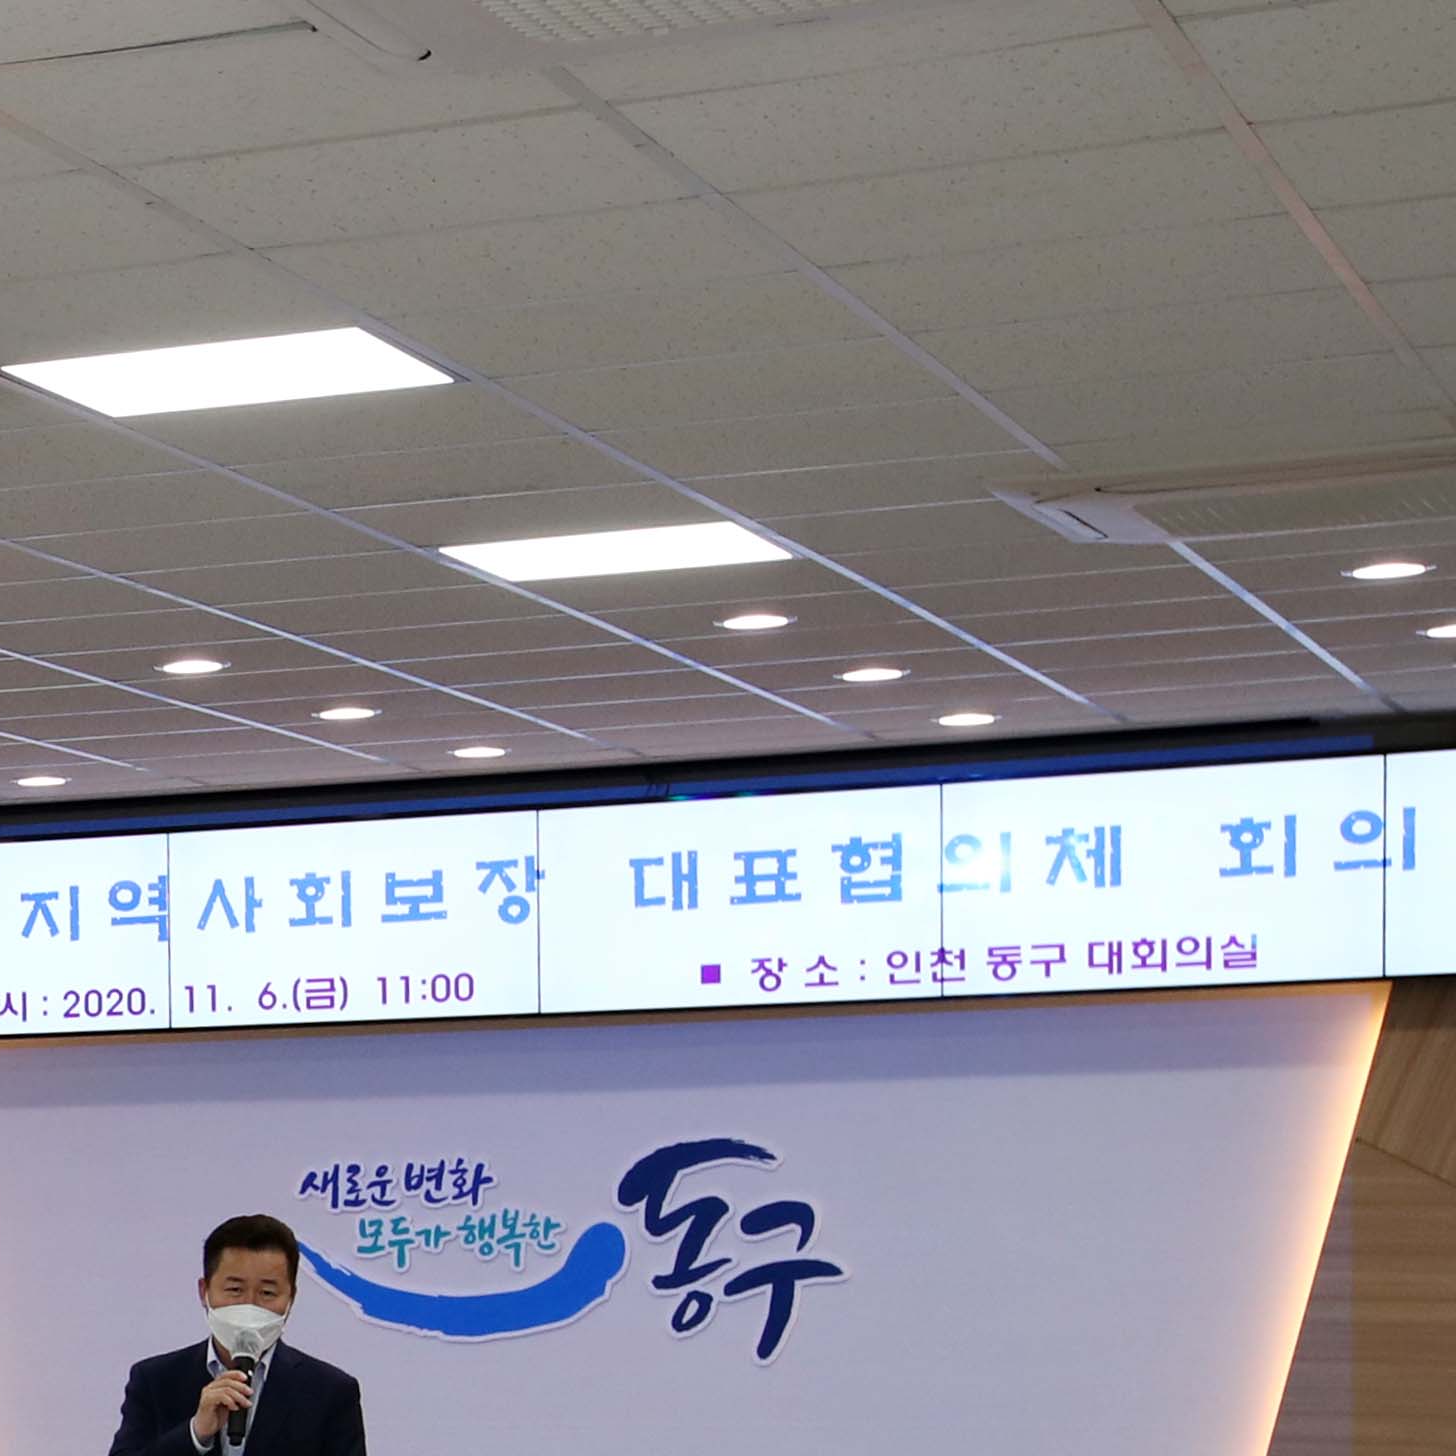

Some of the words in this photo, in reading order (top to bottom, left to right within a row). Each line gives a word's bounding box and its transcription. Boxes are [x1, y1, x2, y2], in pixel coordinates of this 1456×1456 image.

[21, 874, 169, 944] 지역
[198, 856, 546, 934] 사회보장
[629, 822, 1123, 912] 대표협의체
[1218, 805, 1417, 878] 회의
[886, 946, 967, 984] 인천
[986, 943, 1067, 982] 동구
[1088, 934, 1258, 975] 대회의실
[63, 987, 156, 1018] 2020.
[184, 984, 233, 1013] 11.
[377, 972, 475, 1005] 11:00
[299, 1163, 394, 1206] 새로운
[403, 1158, 493, 1207] 변화
[357, 1216, 450, 1268] 모두가
[456, 1209, 565, 1269] 행복한
[619, 1138, 843, 1360] 동구
